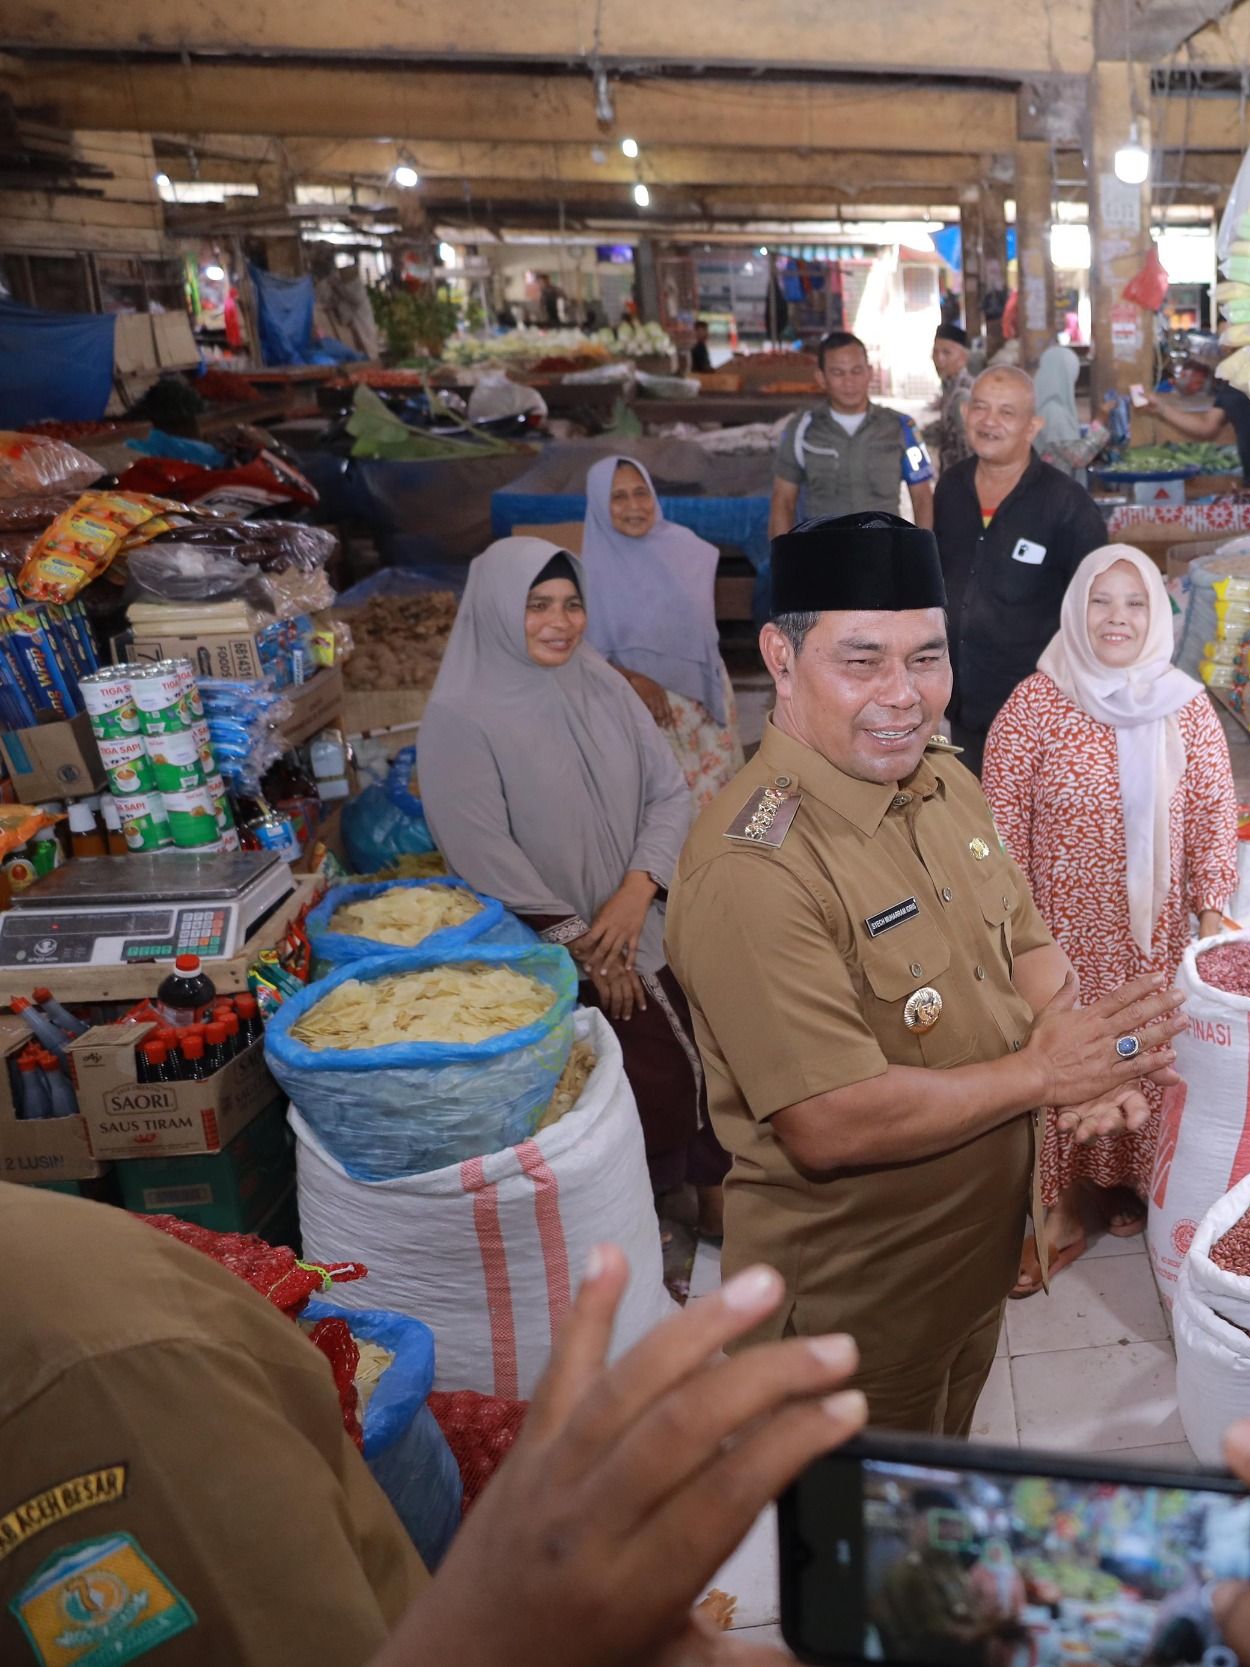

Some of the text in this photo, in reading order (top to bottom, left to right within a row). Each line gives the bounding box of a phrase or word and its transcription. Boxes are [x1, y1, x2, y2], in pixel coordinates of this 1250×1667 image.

[100, 683, 121, 698] TIGA
[120, 742, 141, 754] SAPI
[125, 801, 146, 813] SAPI
[1187, 1015, 1232, 1048] INASI
[111, 1092, 169, 1112] SAORI
[99, 1116, 193, 1134] SAUS TIRAM
[5, 1157, 15, 1171] 2
[15, 1500, 62, 1531] ACEH
[61, 1472, 118, 1508] BESAR
